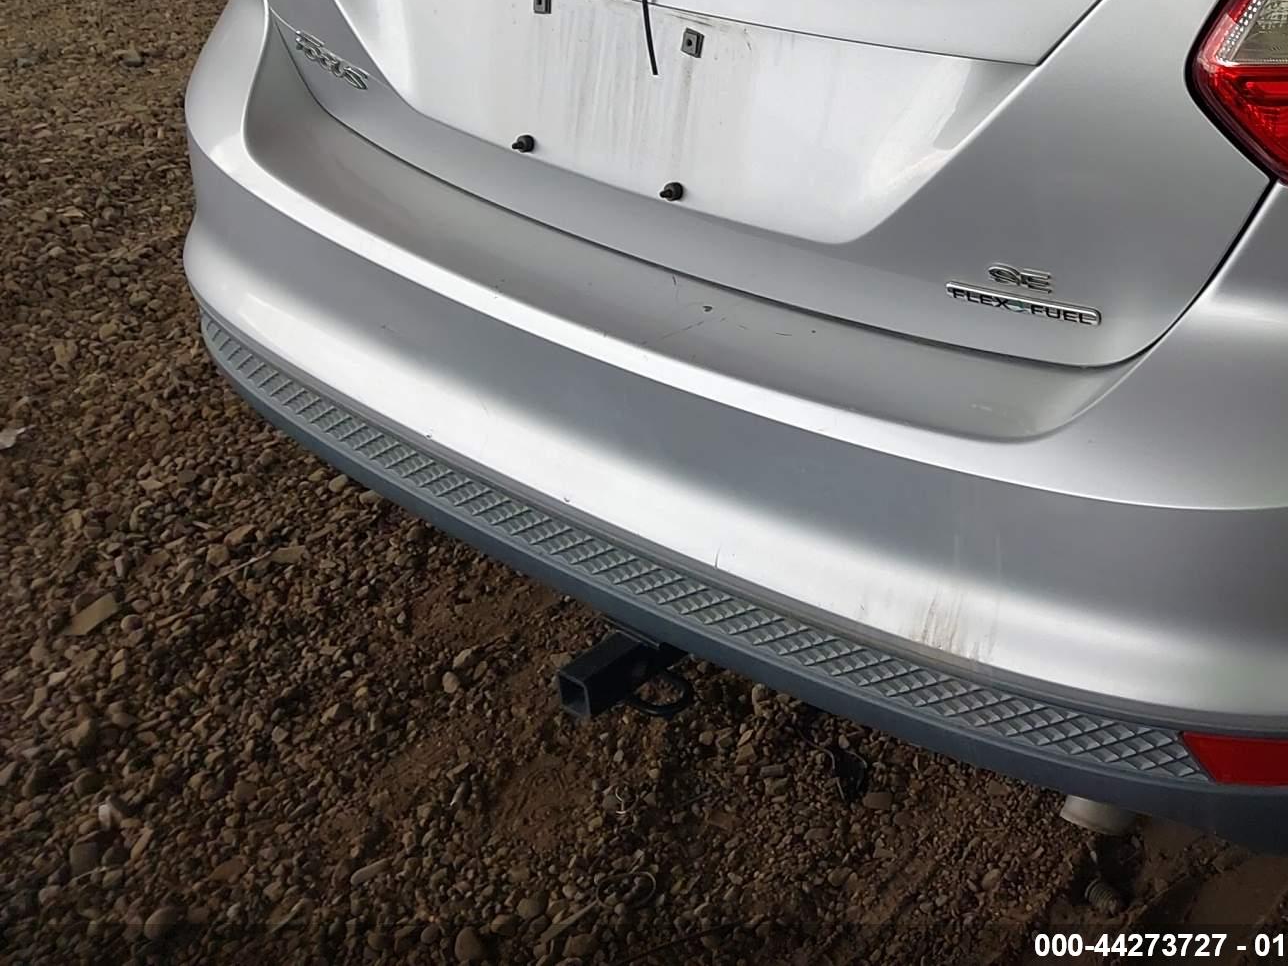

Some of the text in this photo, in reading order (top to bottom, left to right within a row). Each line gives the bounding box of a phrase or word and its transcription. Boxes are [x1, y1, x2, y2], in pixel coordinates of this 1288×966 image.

[988, 264, 1052, 294] SE
[952, 287, 1093, 326] FLEX FUEL
